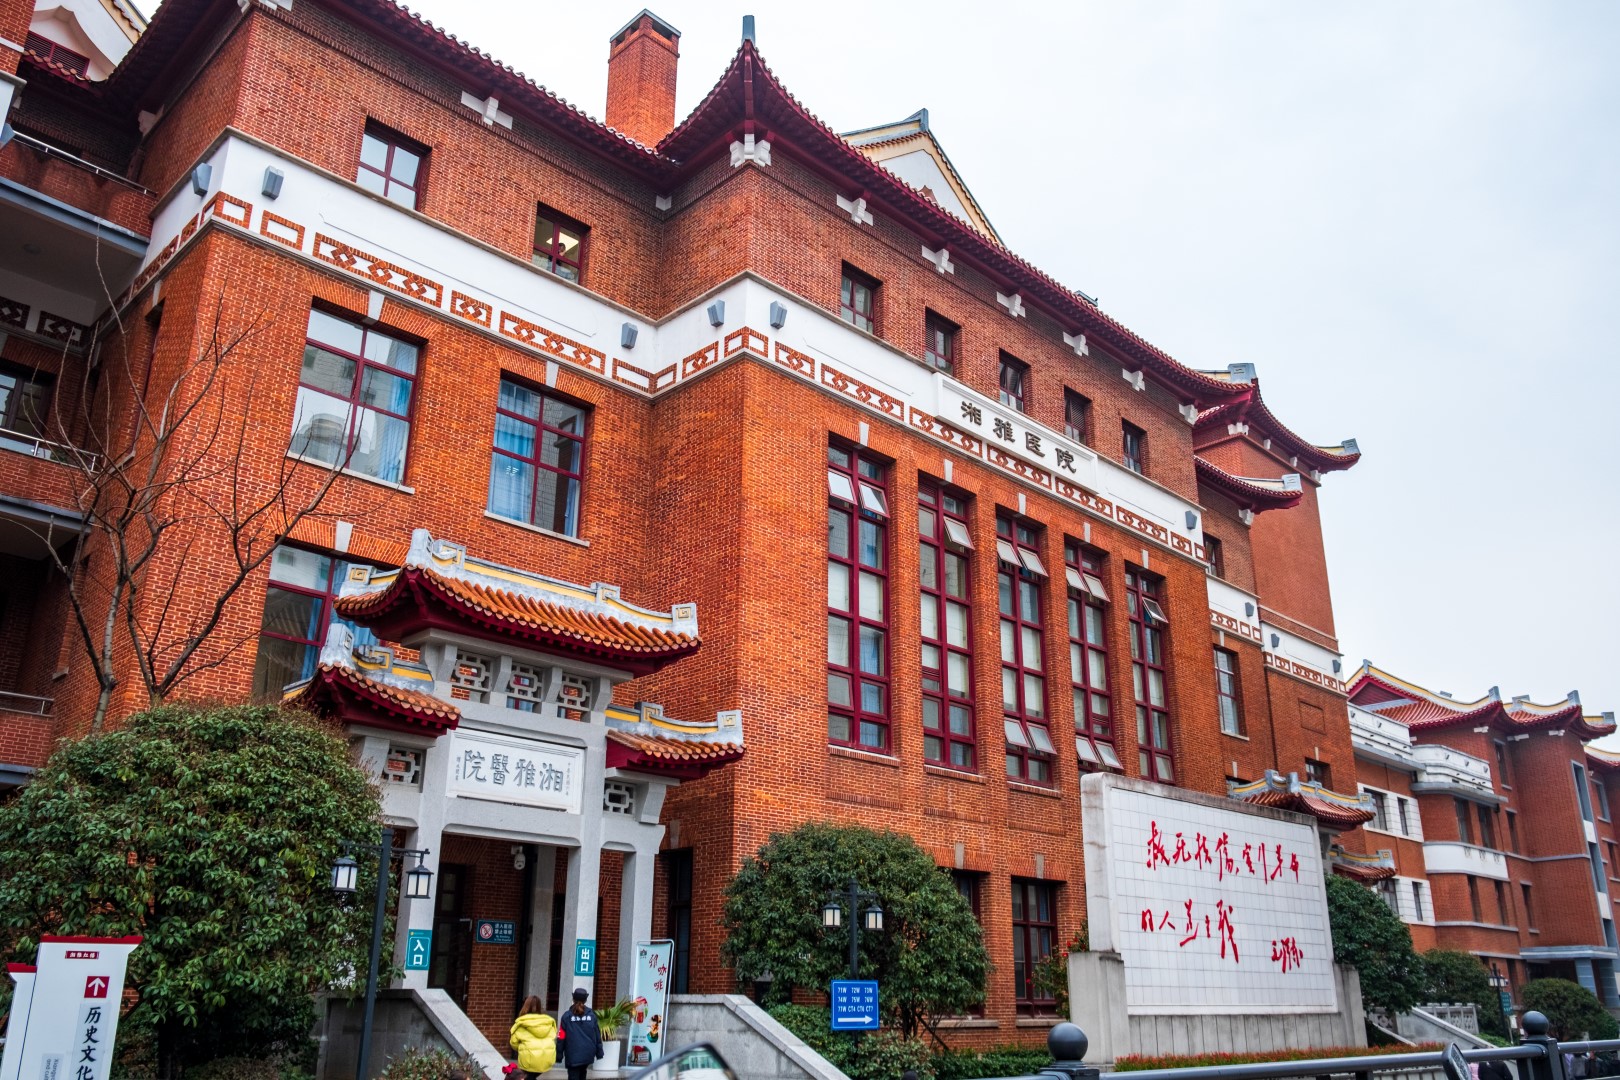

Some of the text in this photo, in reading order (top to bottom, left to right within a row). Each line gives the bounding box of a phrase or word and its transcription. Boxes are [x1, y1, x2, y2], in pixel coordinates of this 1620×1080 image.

[960, 401, 1076, 474] 湘雅医院
[413, 940, 424, 966] 入口
[581, 948, 590, 972] 出口
[76, 1006, 102, 1080] 历史文化
